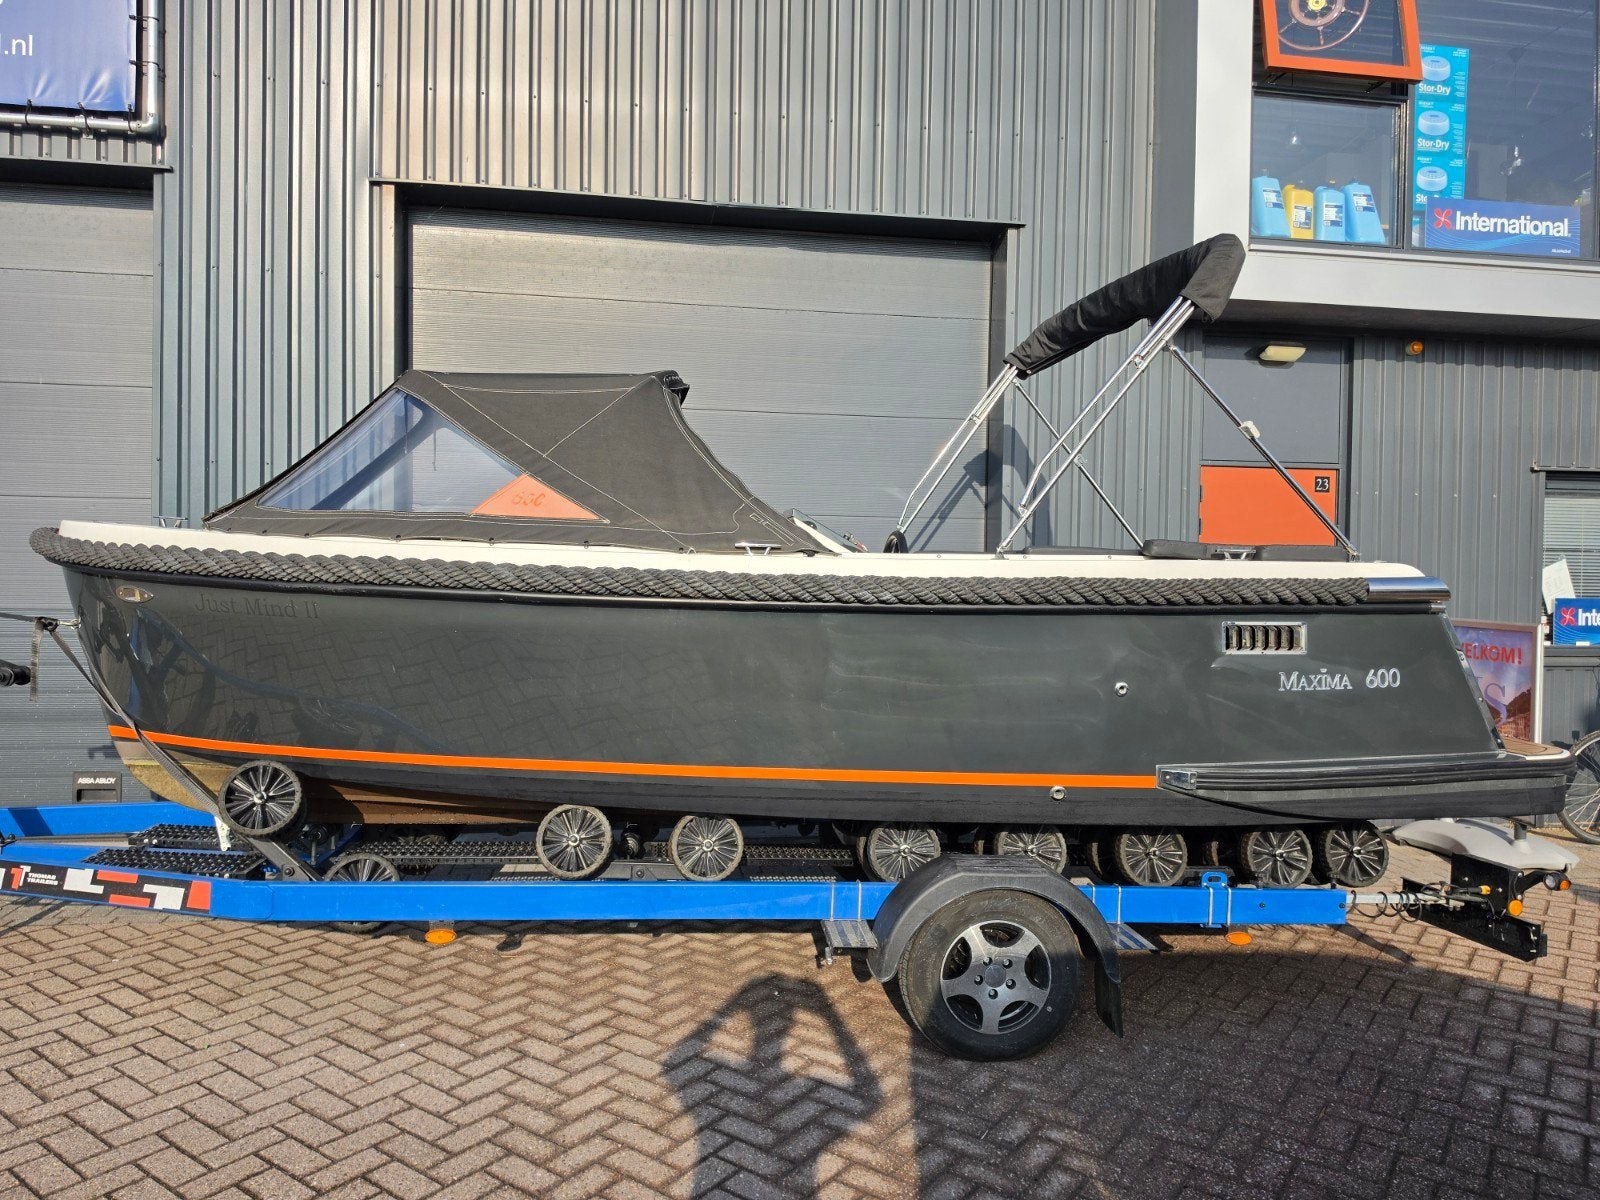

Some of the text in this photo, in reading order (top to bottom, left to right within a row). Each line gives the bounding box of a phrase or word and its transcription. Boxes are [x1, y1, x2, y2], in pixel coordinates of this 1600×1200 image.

[0, 34, 33, 56] .nl
[1418, 82, 1451, 95] Stor-Dry
[1417, 138, 1450, 151] Stor-Dry
[1455, 210, 1569, 237] International
[1316, 478, 1329, 491] 23
[1366, 668, 1401, 688] 600
